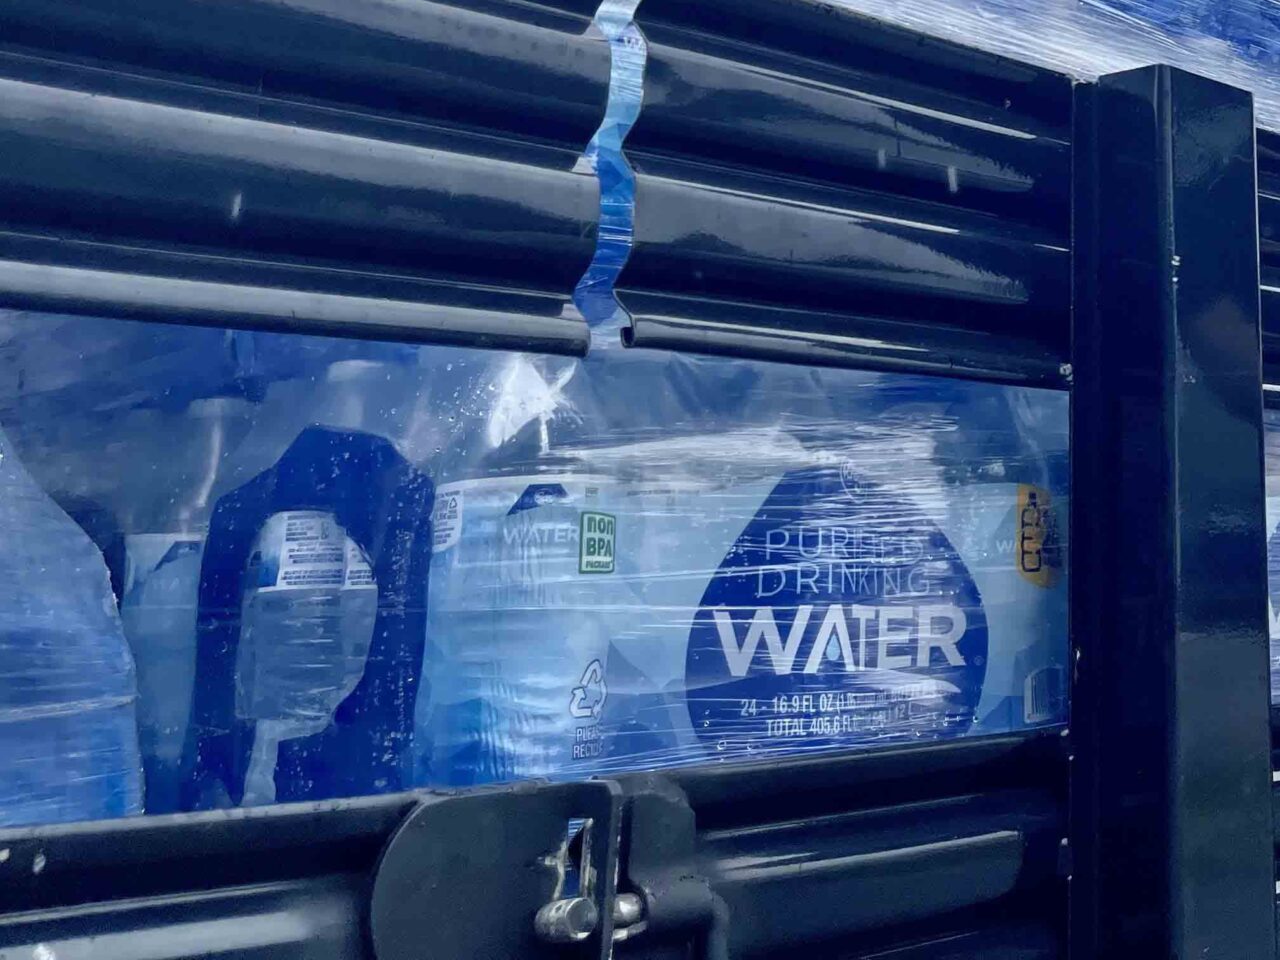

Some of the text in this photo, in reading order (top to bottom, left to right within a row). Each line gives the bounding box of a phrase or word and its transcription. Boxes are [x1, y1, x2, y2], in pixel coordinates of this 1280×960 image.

[503, 526, 578, 545] WATER
[587, 516, 613, 535] non
[586, 537, 612, 557] BPA
[757, 562, 931, 598] DRINKING
[713, 603, 967, 676] WATER
[740, 698, 757, 716] 24
[771, 694, 800, 714] 16.9
[802, 693, 816, 713] FL
[819, 692, 834, 712] OZ
[766, 718, 807, 737] TOTAL
[809, 716, 841, 735] 405.6
